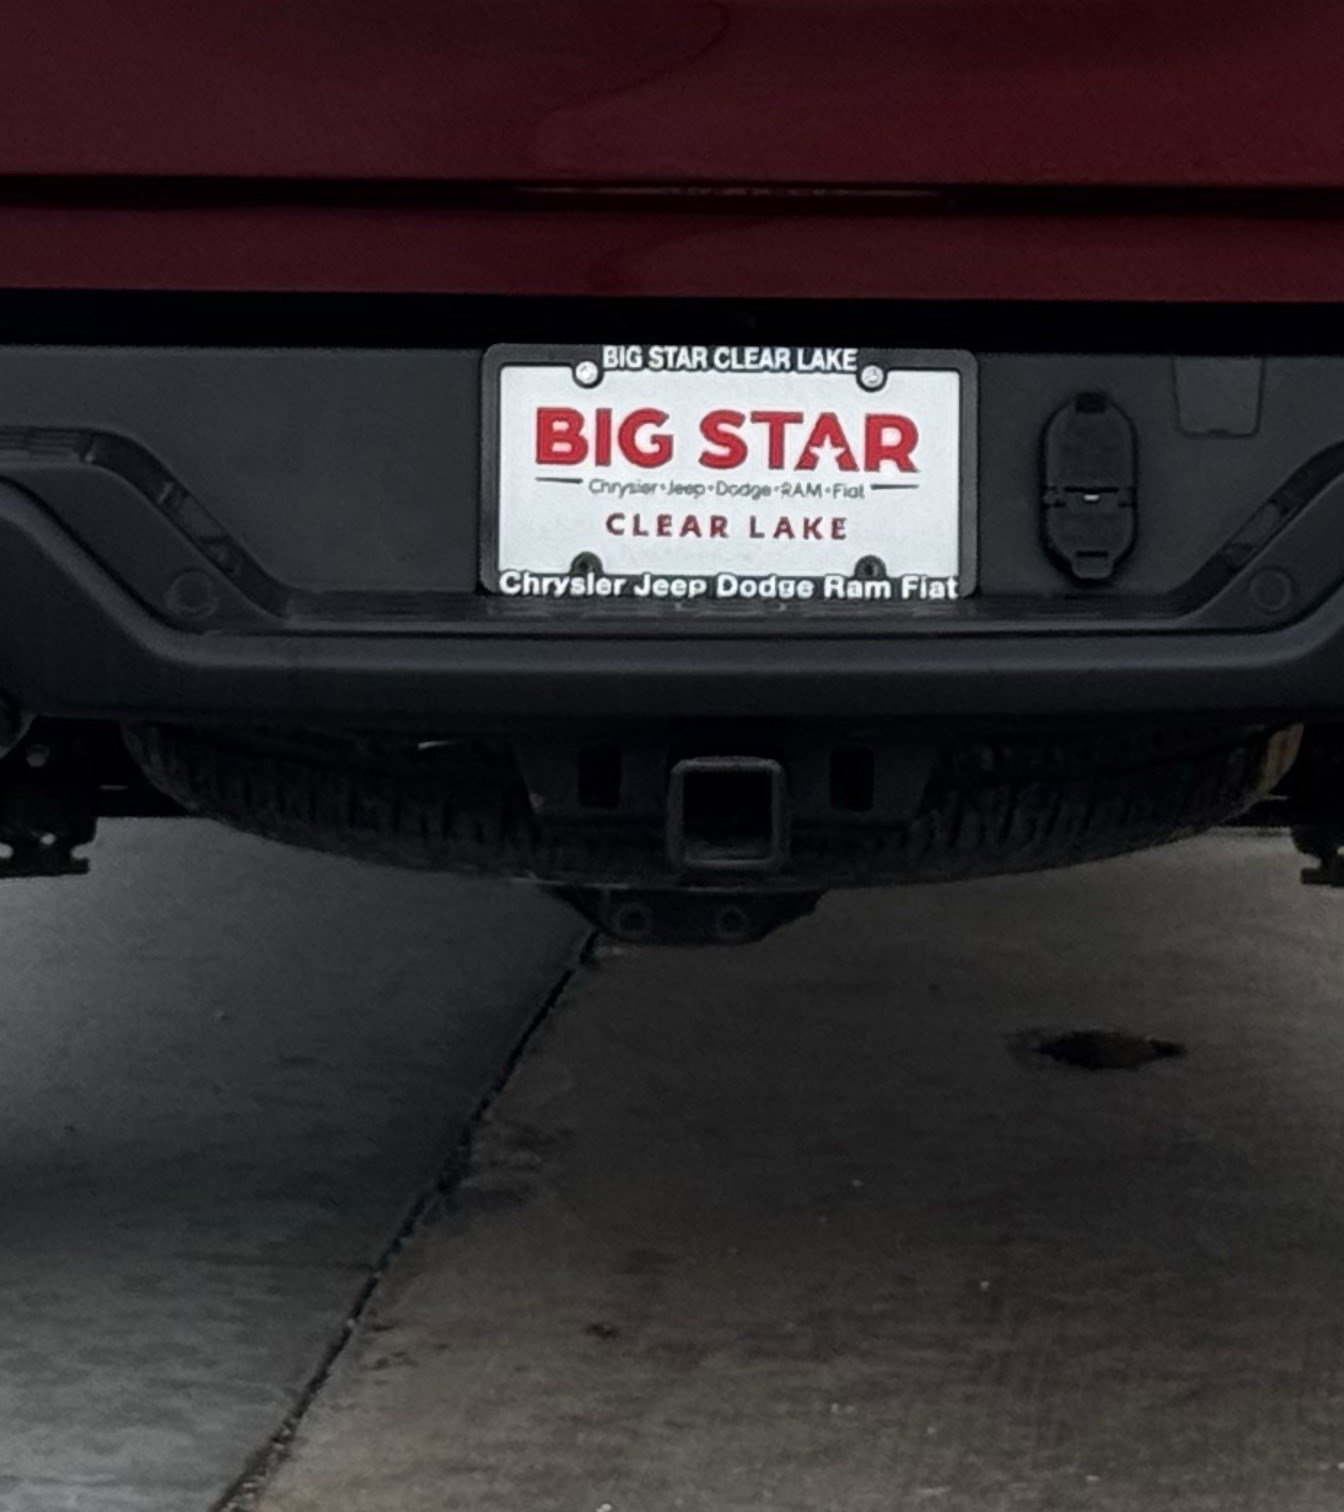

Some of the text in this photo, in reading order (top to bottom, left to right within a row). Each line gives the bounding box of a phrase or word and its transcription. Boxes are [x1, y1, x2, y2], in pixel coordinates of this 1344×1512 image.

[602, 346, 858, 372] BIG STAR CLEAR LAKE
[535, 407, 919, 473] BIG STAR
[605, 512, 848, 540] CLEAR LAKE
[499, 570, 959, 600] Chrysler Jeep Dodge Ram Fiat
